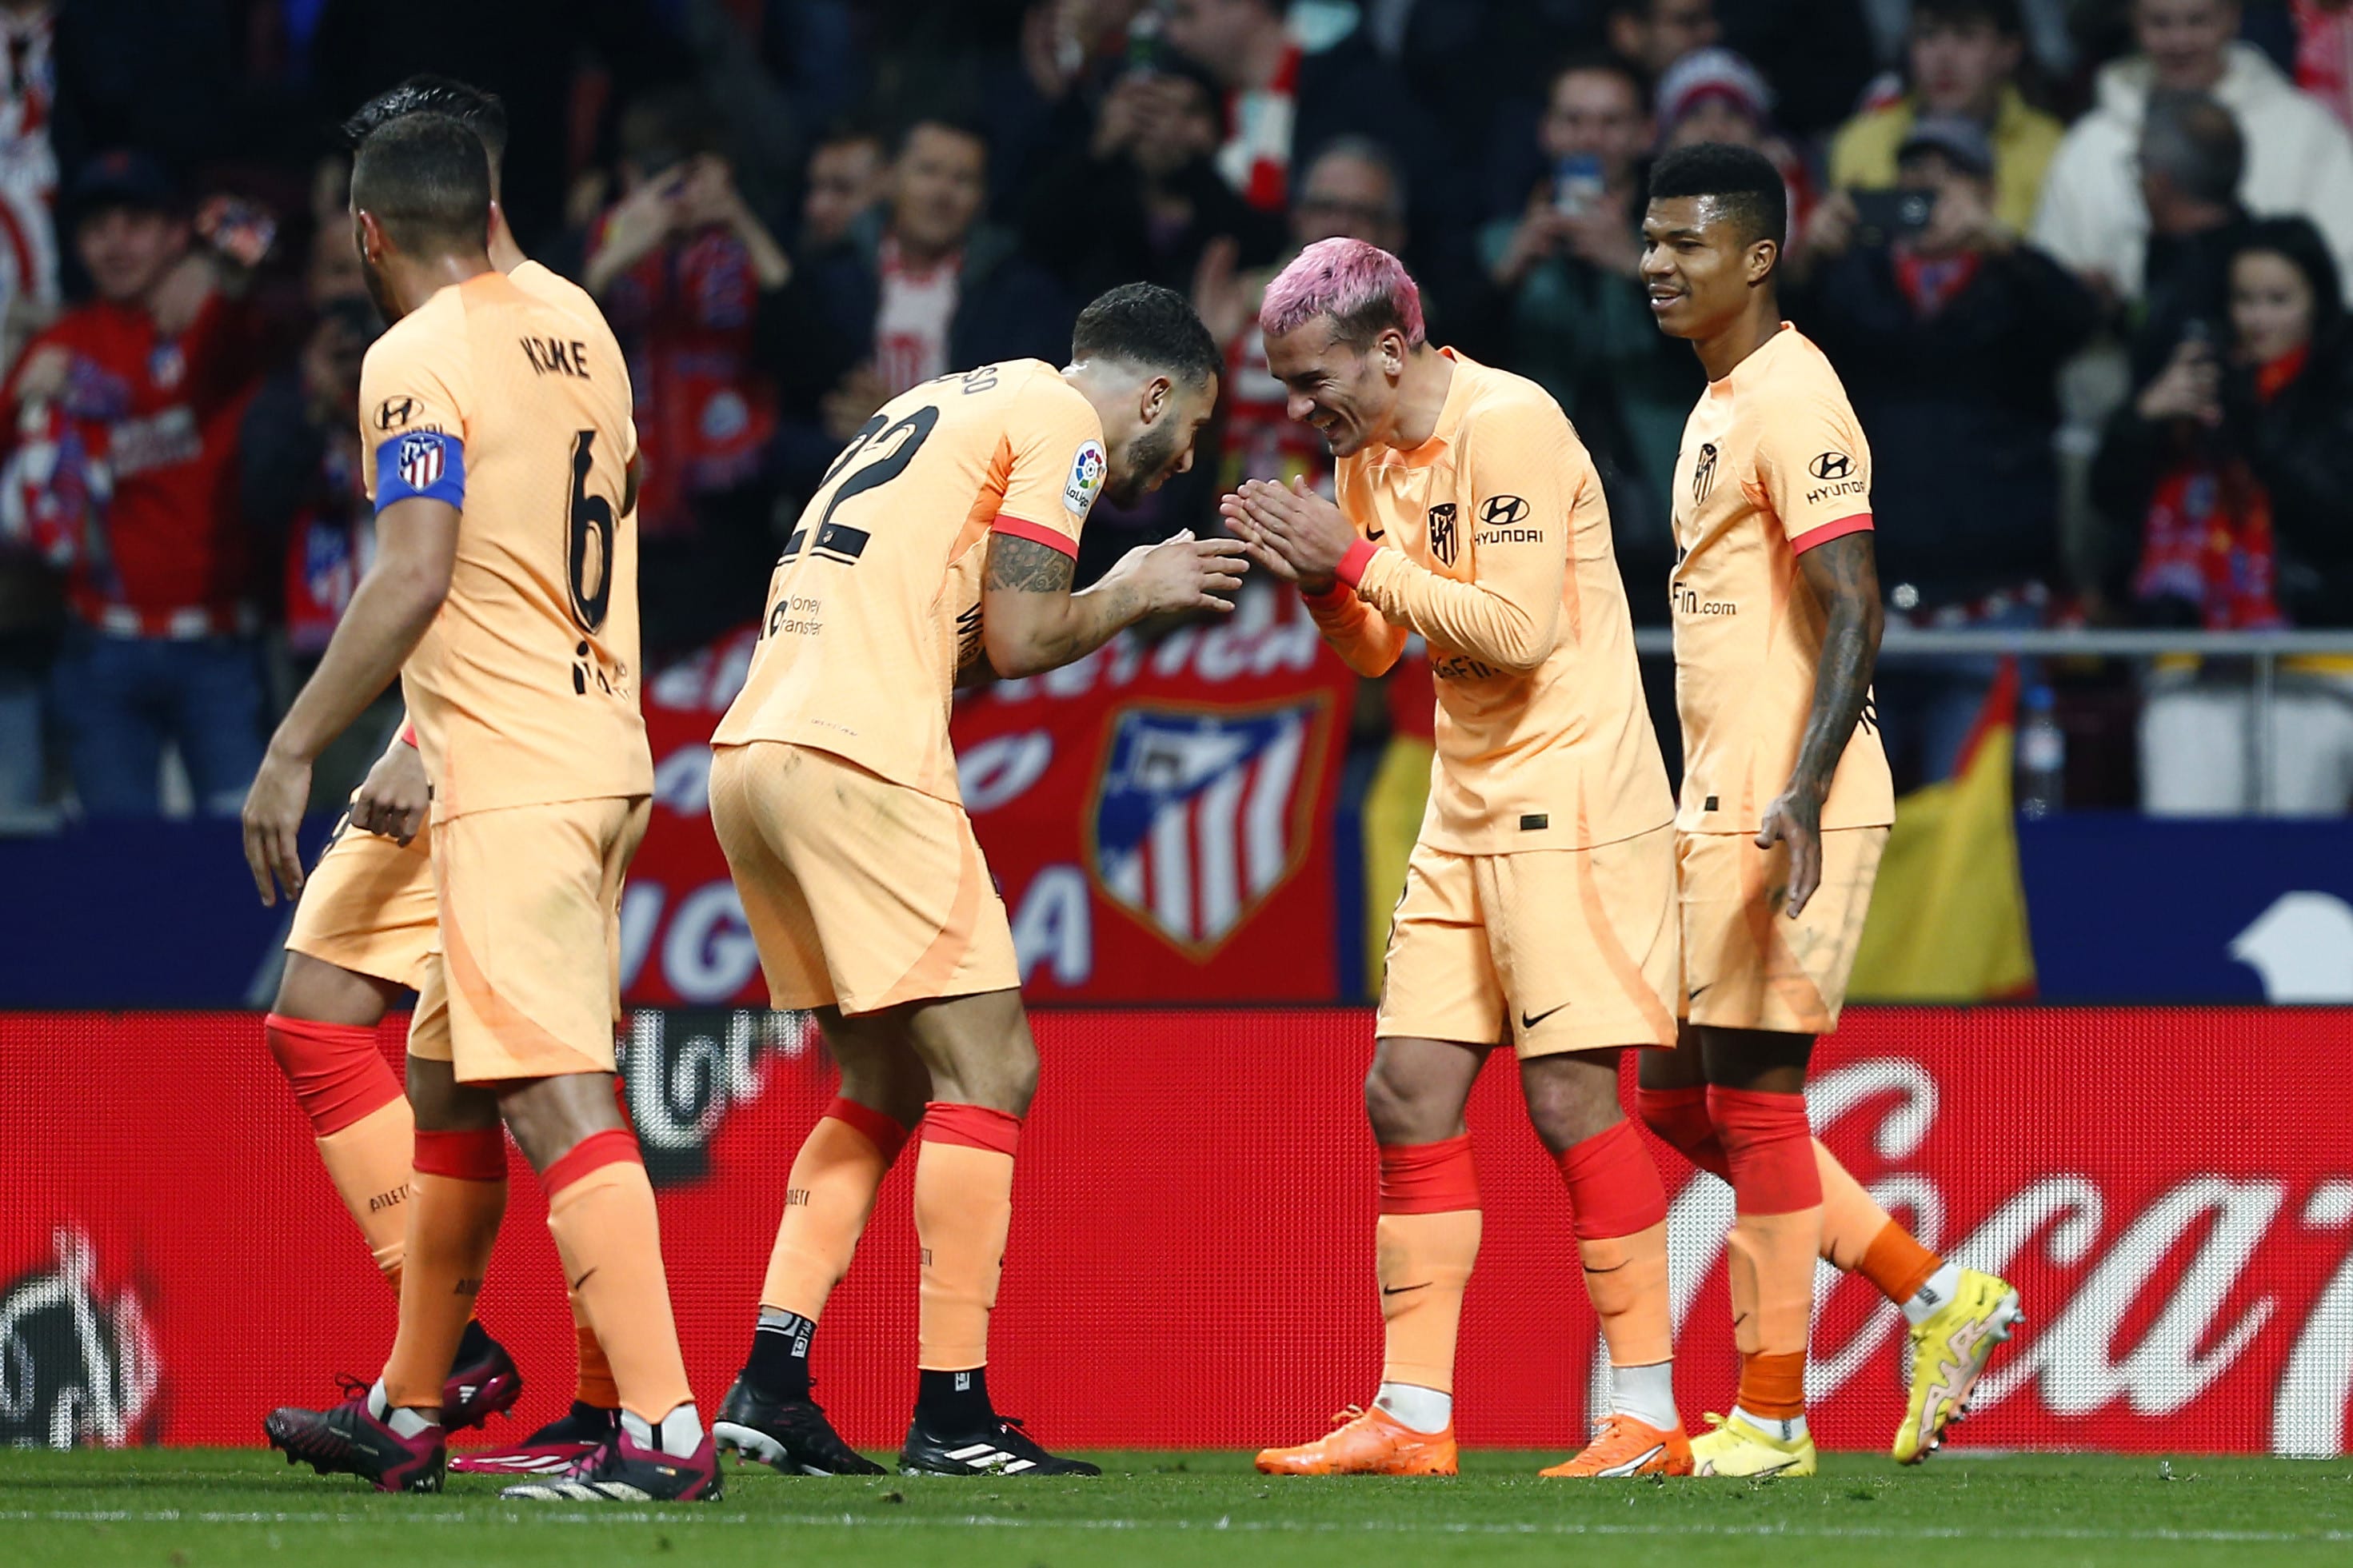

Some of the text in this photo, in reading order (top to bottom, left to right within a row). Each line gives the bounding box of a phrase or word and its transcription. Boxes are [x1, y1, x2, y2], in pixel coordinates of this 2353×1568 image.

[518, 336, 591, 381] KOKE
[777, 405, 940, 566] 22
[1065, 485, 1089, 508] LaLiga
[1805, 481, 1866, 505] HYUNDA
[565, 429, 613, 636] 6
[1473, 529, 1544, 547] HYUNDAI
[788, 593, 821, 616] oney
[779, 617, 824, 636] ransfer
